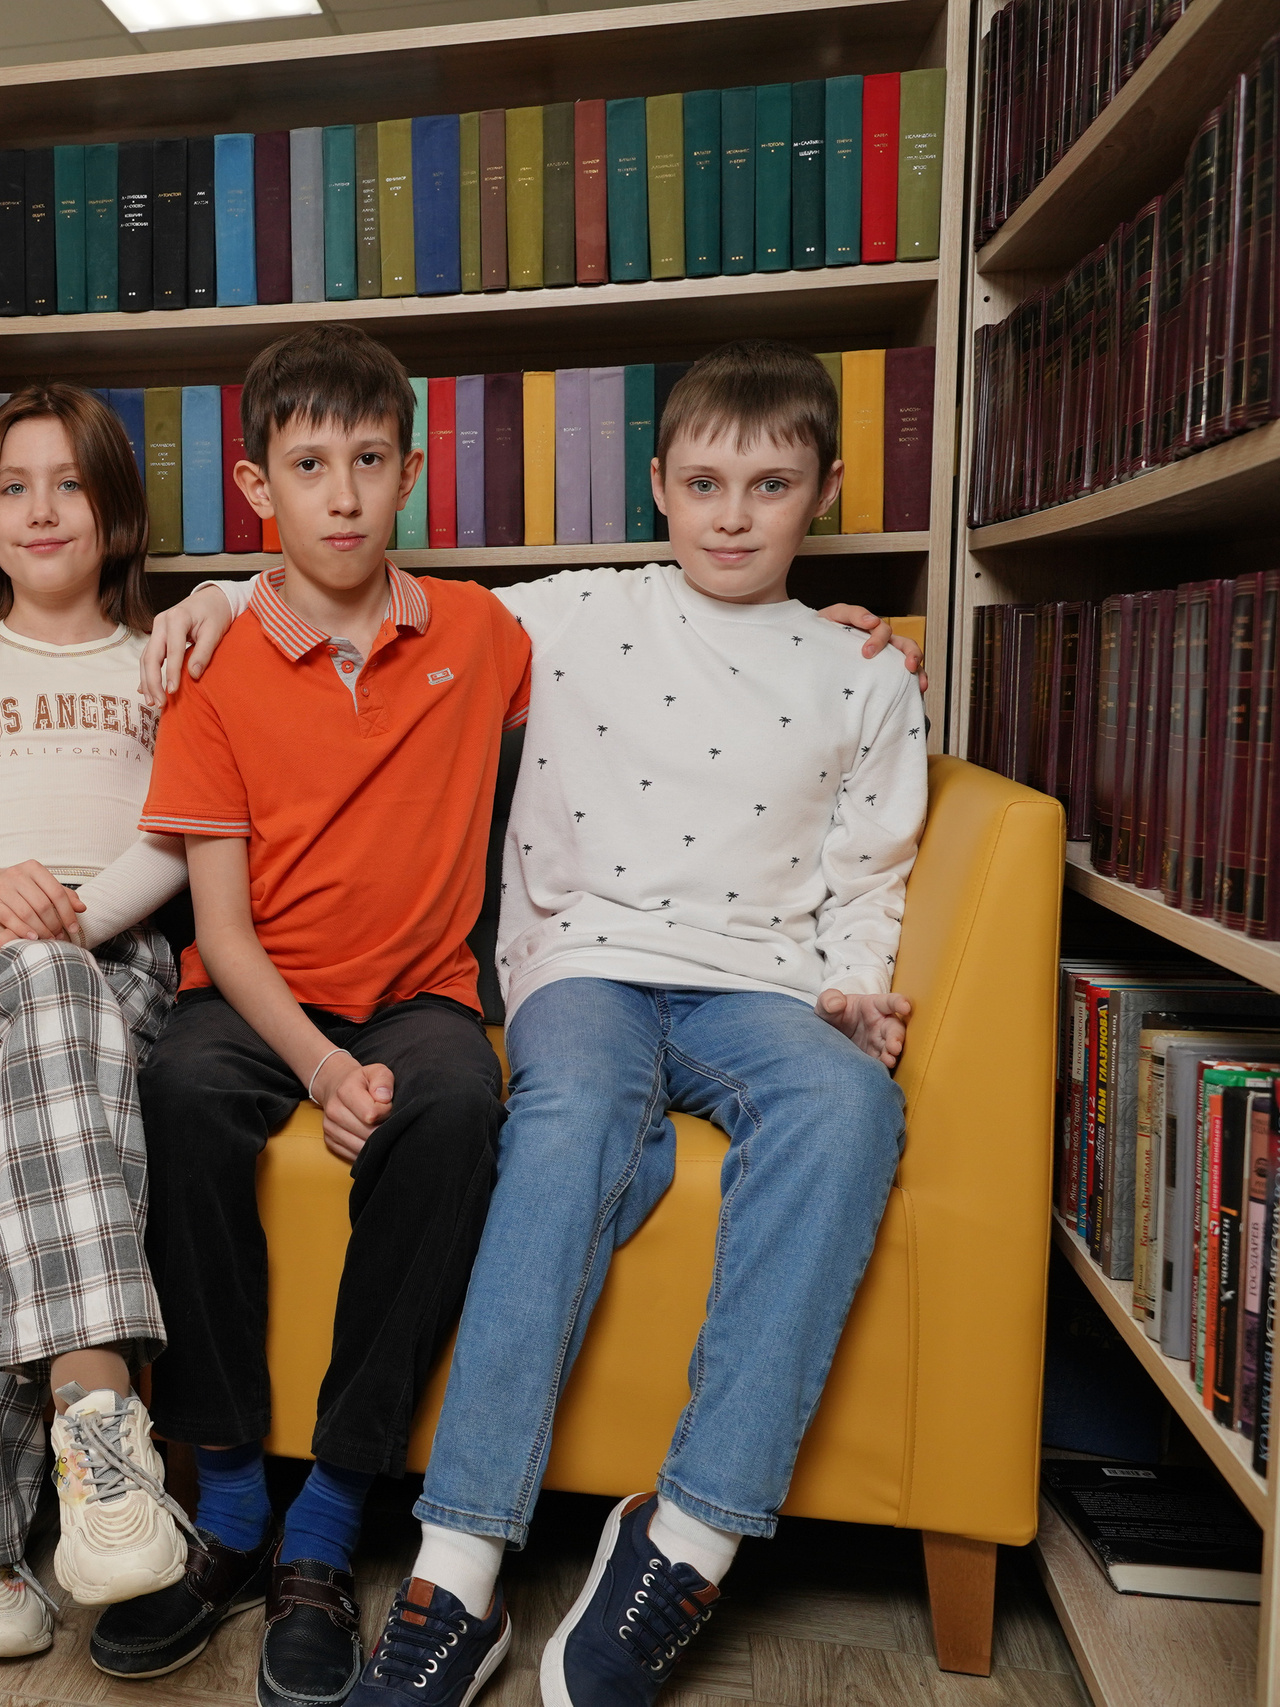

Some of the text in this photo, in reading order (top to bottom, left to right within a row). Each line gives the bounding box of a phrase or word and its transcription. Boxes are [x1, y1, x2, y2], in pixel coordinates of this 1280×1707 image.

[1097, 1008, 1109, 1125] ИЛЬИ ГЛАЗУНОВА
[1087, 1095, 1096, 1147] 1812
[1069, 1183, 1078, 1202] Мне
[1070, 1154, 1078, 1180] жаль
[1211, 1119, 1221, 1210] екатерина красавина
[1220, 1218, 1231, 1285] И.ГРЕКОВА
[1248, 1222, 1259, 1297] ГОСУДАРЕВ
